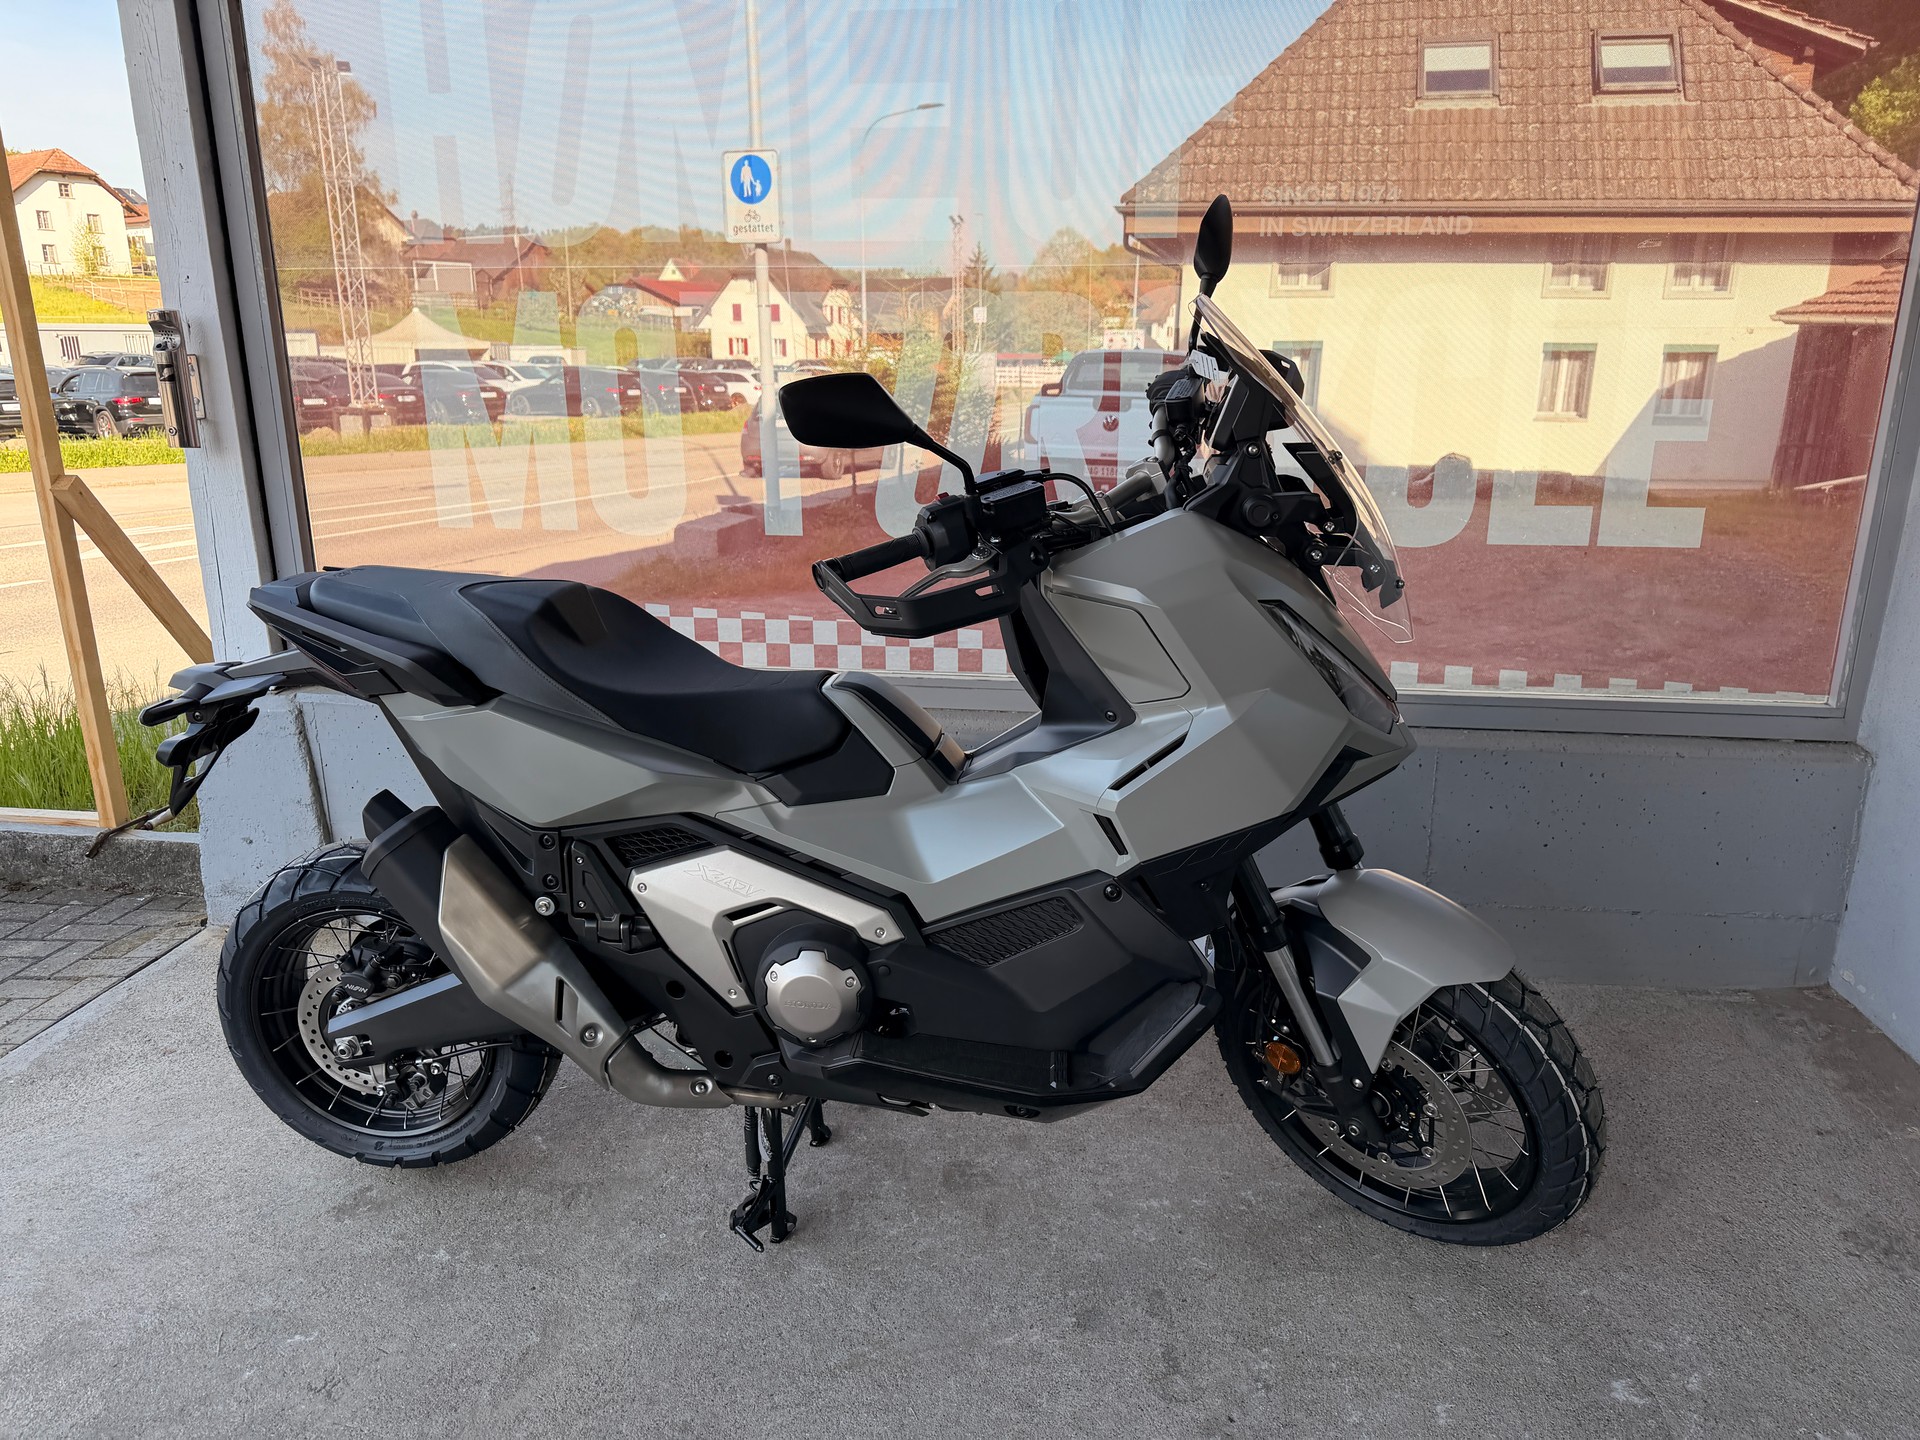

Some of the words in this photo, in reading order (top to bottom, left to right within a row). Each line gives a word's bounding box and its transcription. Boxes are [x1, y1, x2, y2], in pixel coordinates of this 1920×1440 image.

[381, 0, 956, 245] HOME
[1260, 185, 1338, 206] SINCE
[1347, 185, 1400, 205] 1974
[733, 223, 775, 236] gestattet
[1259, 217, 1284, 237] IN
[1291, 216, 1474, 236] SWITZERLAND
[784, 1000, 833, 1010] HONDA
